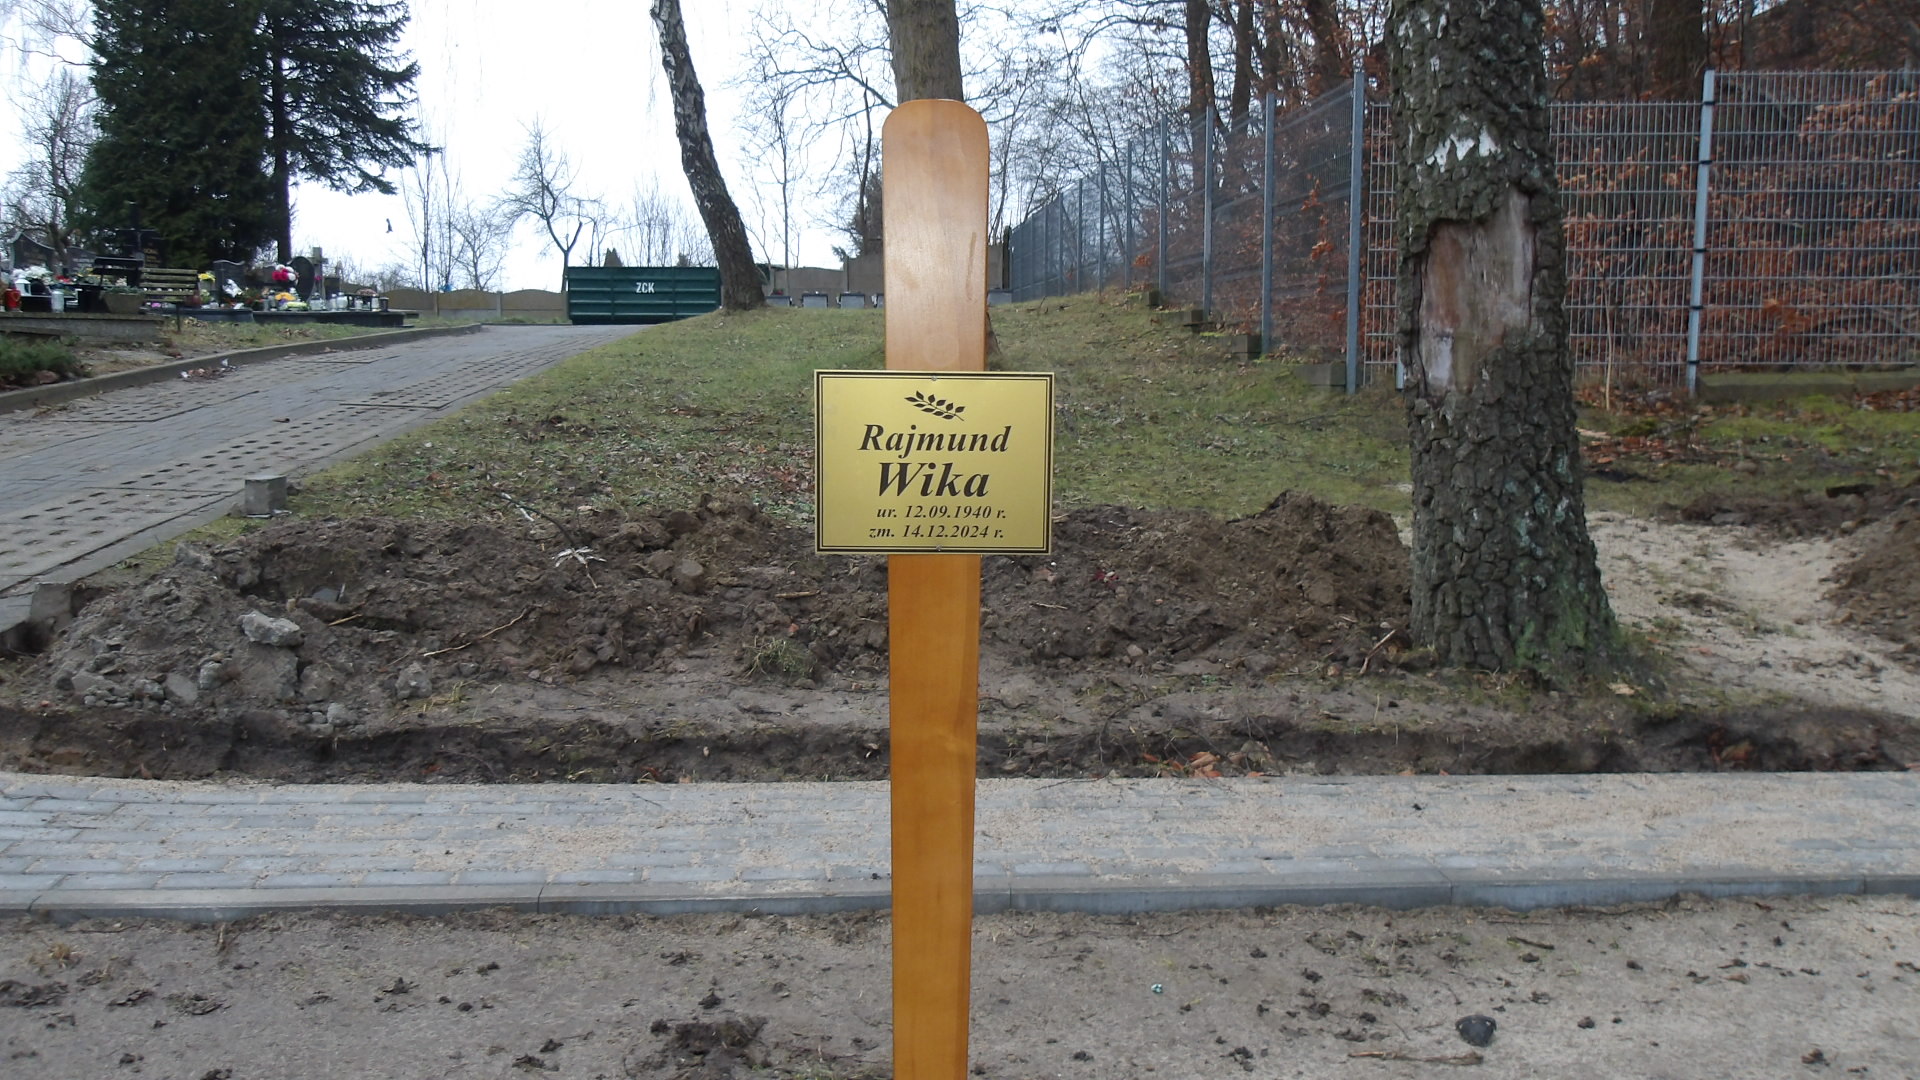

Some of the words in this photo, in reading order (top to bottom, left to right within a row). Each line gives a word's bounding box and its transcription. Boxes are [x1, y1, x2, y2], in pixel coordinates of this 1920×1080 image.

[858, 424, 1011, 459] Rajmund
[878, 462, 990, 498] Wika
[876, 508, 897, 518] ur.
[904, 505, 992, 519] 12.09.1940
[996, 509, 1006, 519] r.
[868, 528, 895, 539] zm.
[902, 524, 989, 539] 14.12.2024
[993, 529, 1004, 539] r.
